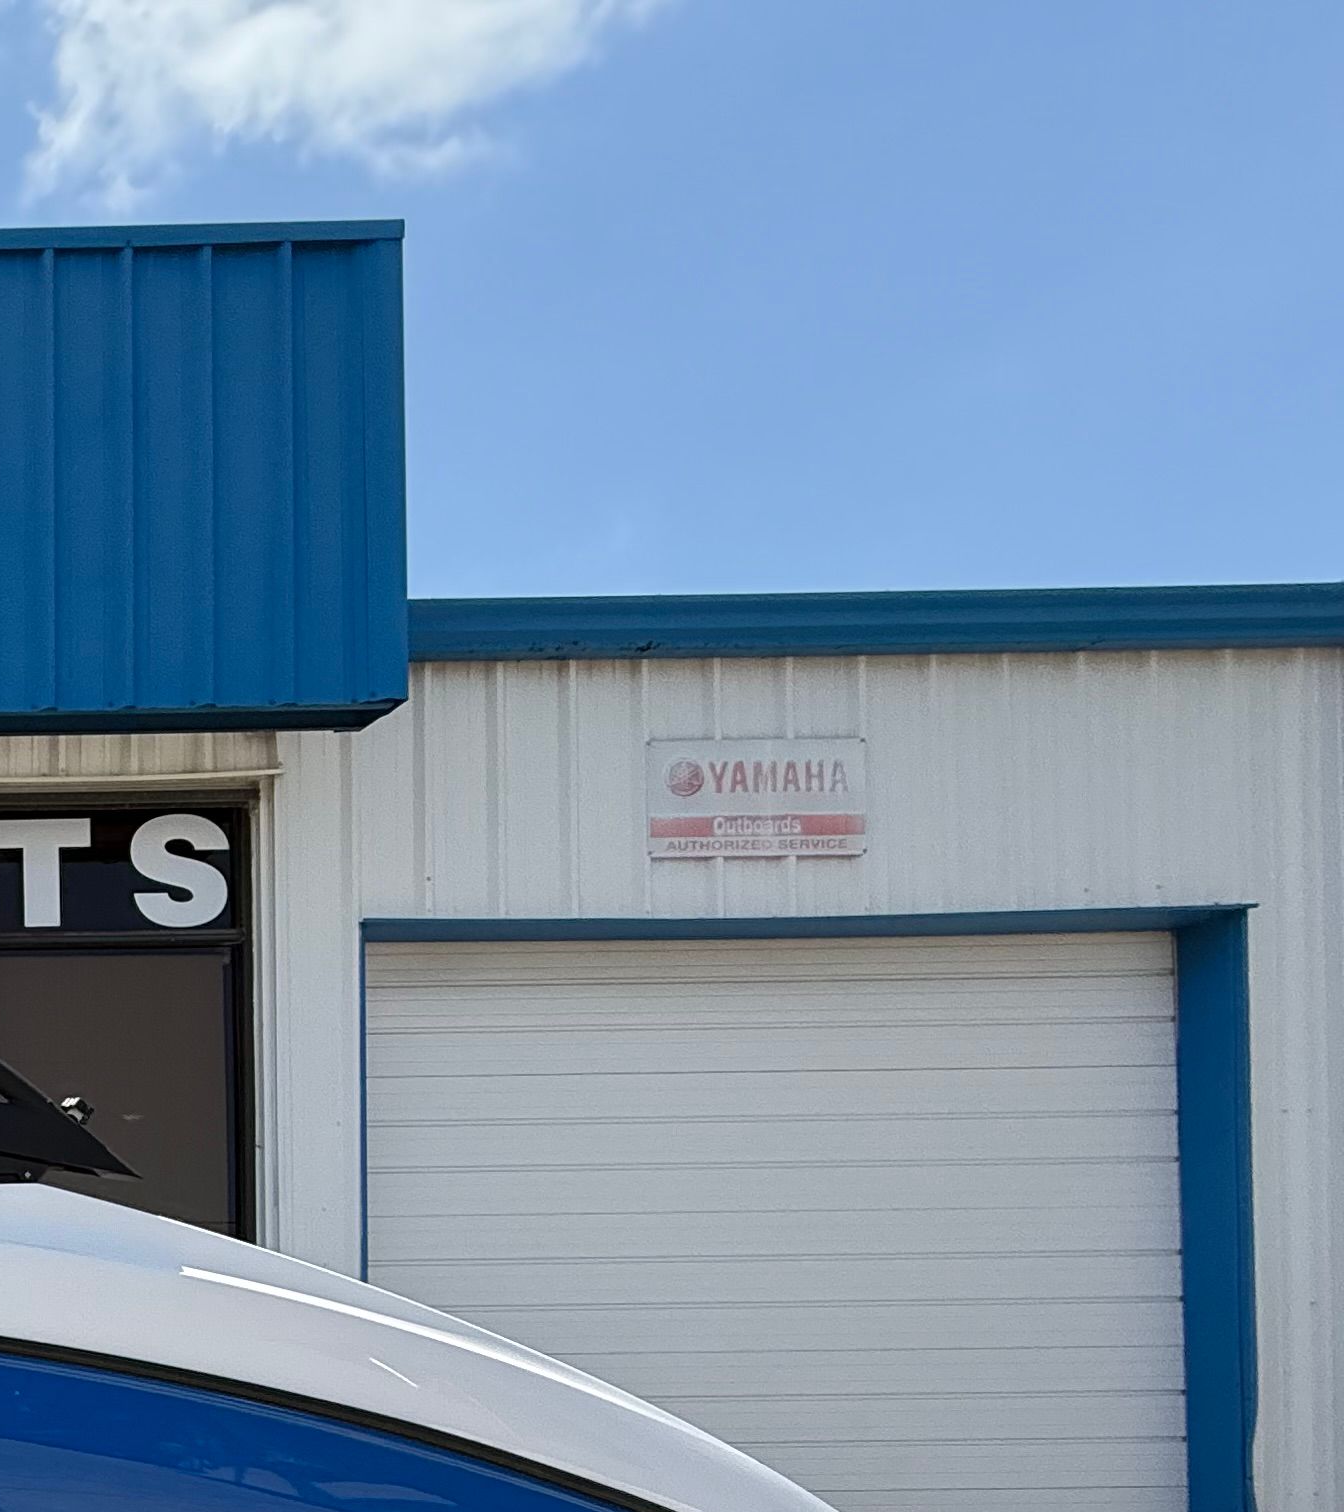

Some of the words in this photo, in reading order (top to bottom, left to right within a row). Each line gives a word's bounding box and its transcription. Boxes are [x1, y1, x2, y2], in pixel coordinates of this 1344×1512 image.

[708, 759, 849, 793] YAMAHA
[713, 816, 802, 835] Outboards
[665, 839, 773, 852] AUTHORIZED
[778, 838, 848, 851] SERVICE
